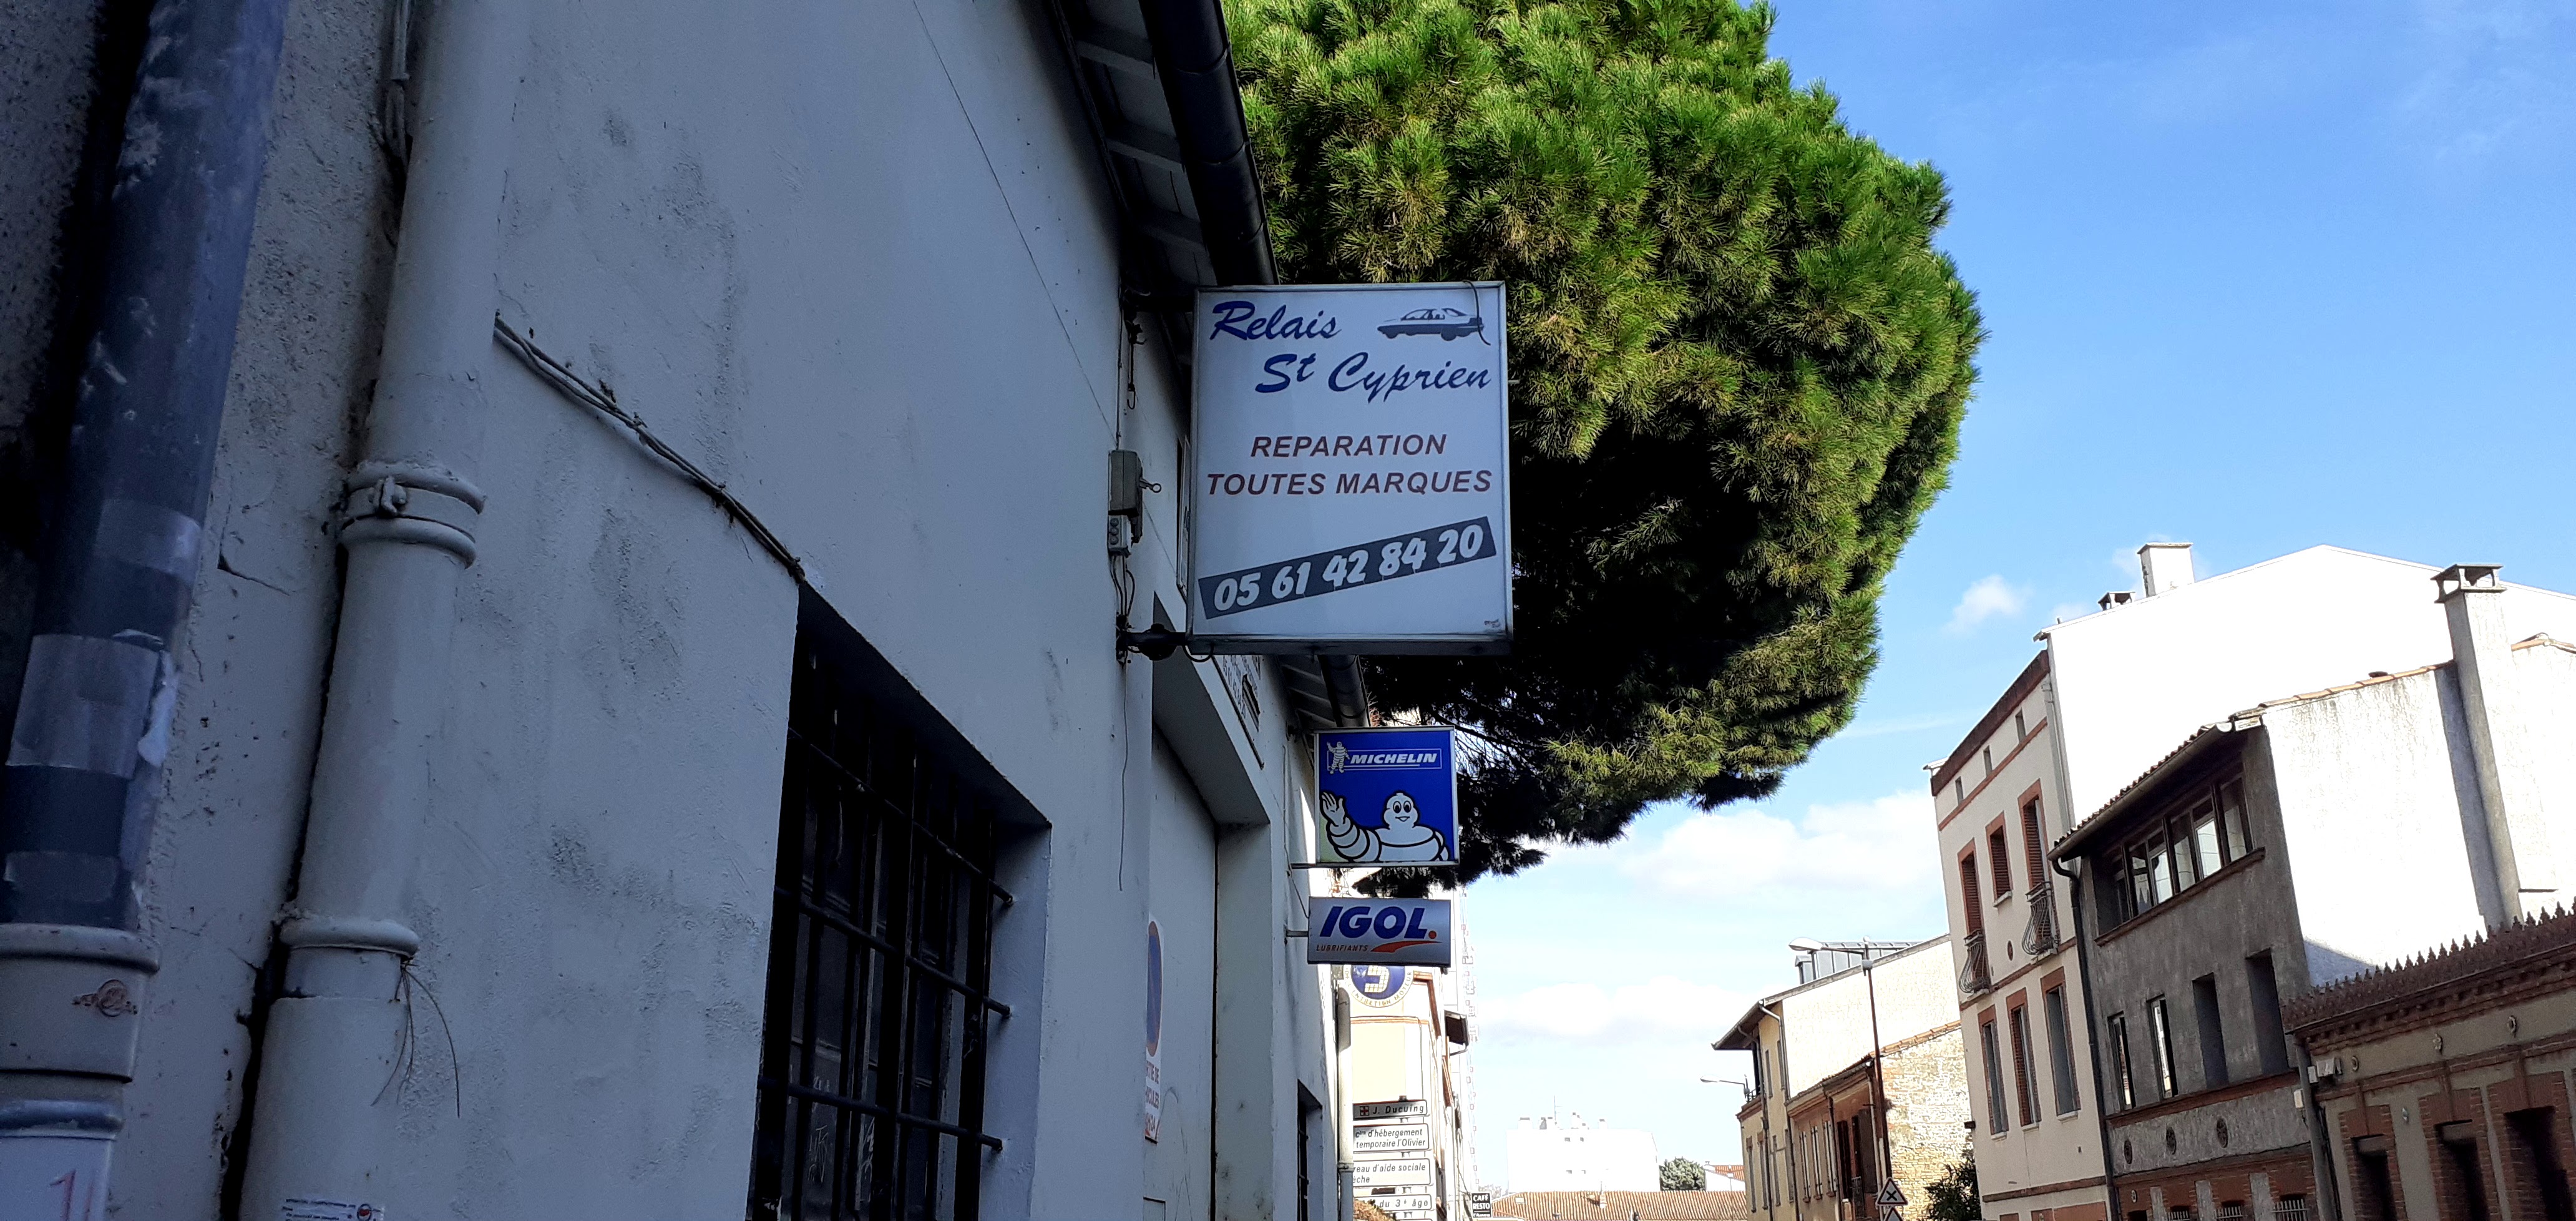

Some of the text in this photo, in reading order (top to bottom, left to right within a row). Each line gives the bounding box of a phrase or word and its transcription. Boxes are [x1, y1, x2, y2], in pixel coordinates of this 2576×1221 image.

[1209, 300, 1342, 340] Relais
[1255, 352, 1491, 403] St Cyprien
[1251, 434, 1447, 458] REPARATION
[1207, 469, 1492, 495] TOUTES MARQUES
[1214, 524, 1484, 611] 05 61 42 84 20
[1350, 753, 1437, 764] MICHELIN
[1394, 972, 1412, 1000] MOTEUR
[1372, 1104, 1424, 1114] J. Ducuing
[1368, 1129, 1423, 1139] d'hébergement
[1356, 1138, 1426, 1149] temporaire l'Olivier
[1372, 1164, 1395, 1172] d'aide
[1398, 1162, 1426, 1171] sociale
[1412, 1199, 1428, 1209] âge
